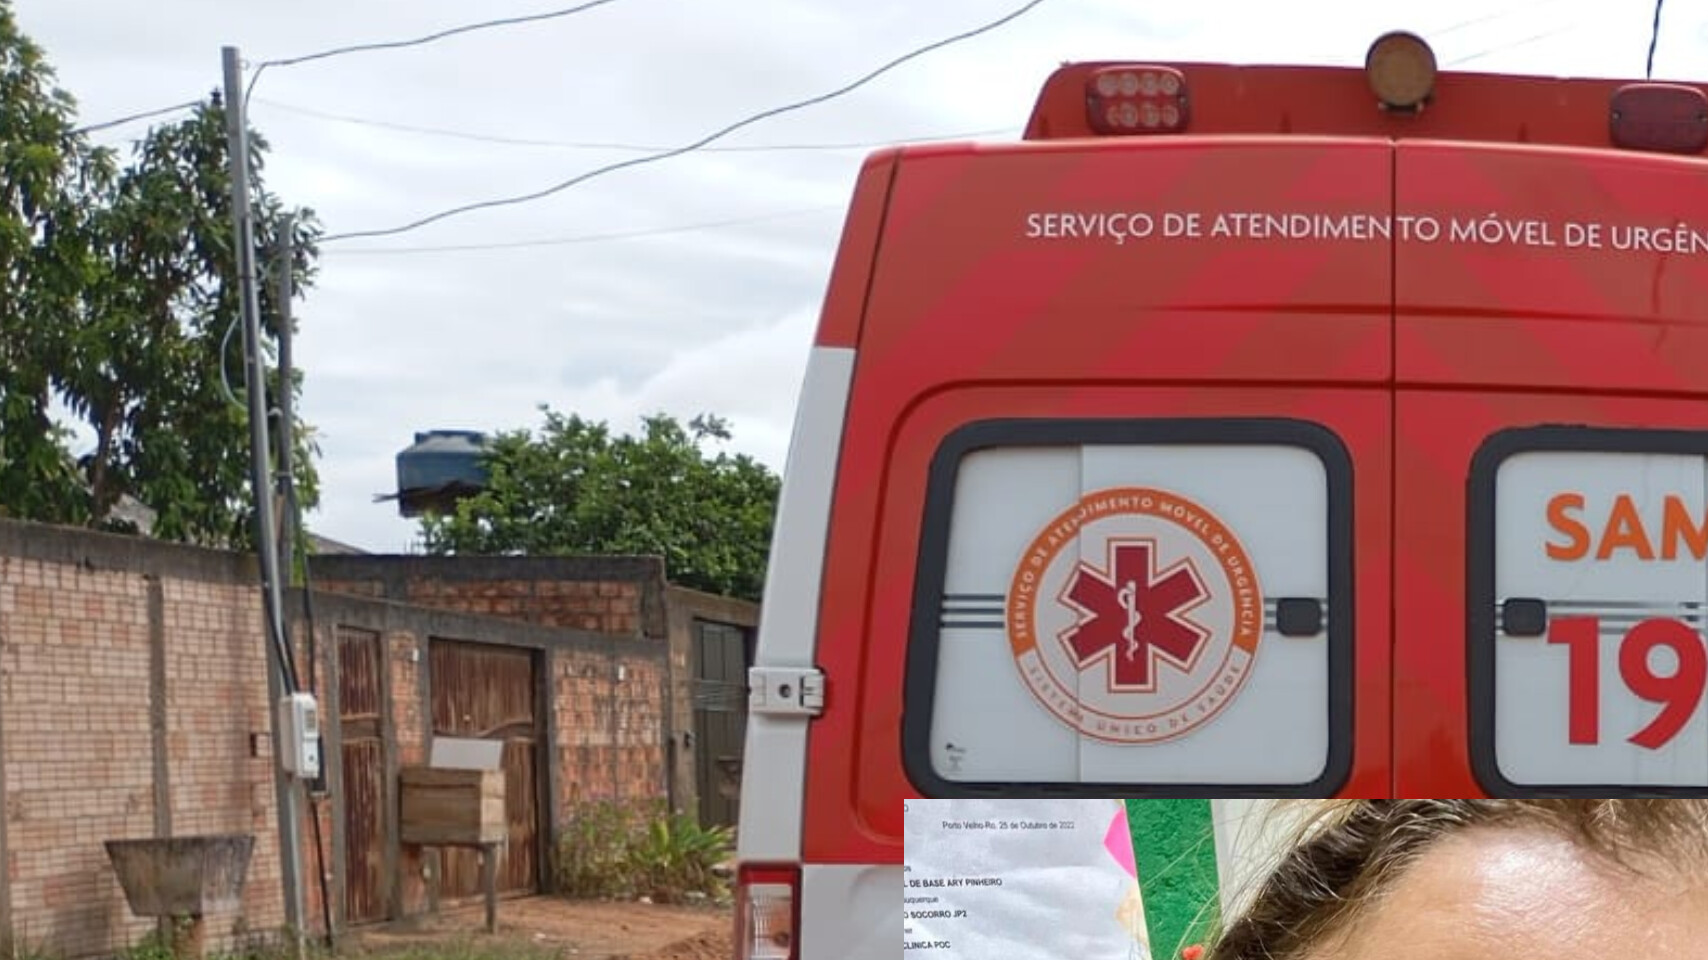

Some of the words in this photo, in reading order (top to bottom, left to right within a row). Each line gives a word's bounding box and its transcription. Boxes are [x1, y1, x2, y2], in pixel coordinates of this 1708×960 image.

[1026, 213, 1155, 246] SERVIÇO
[1163, 213, 1202, 237] DE
[1211, 213, 1441, 241] ATENDIMENTO
[1449, 212, 1557, 246] MÓVEL
[1565, 223, 1603, 248] DE
[1015, 571, 1034, 638] SERVIÇO
[1033, 547, 1048, 568] DE
[1211, 533, 1230, 555] DE
[910, 879, 921, 888] DE
[923, 879, 945, 888] BASE
[947, 878, 963, 887] ARY
[965, 878, 1003, 887] PINHEIRO
[910, 911, 952, 919] SOCORRO
[953, 910, 968, 918] JP2
[934, 941, 951, 949] POC
